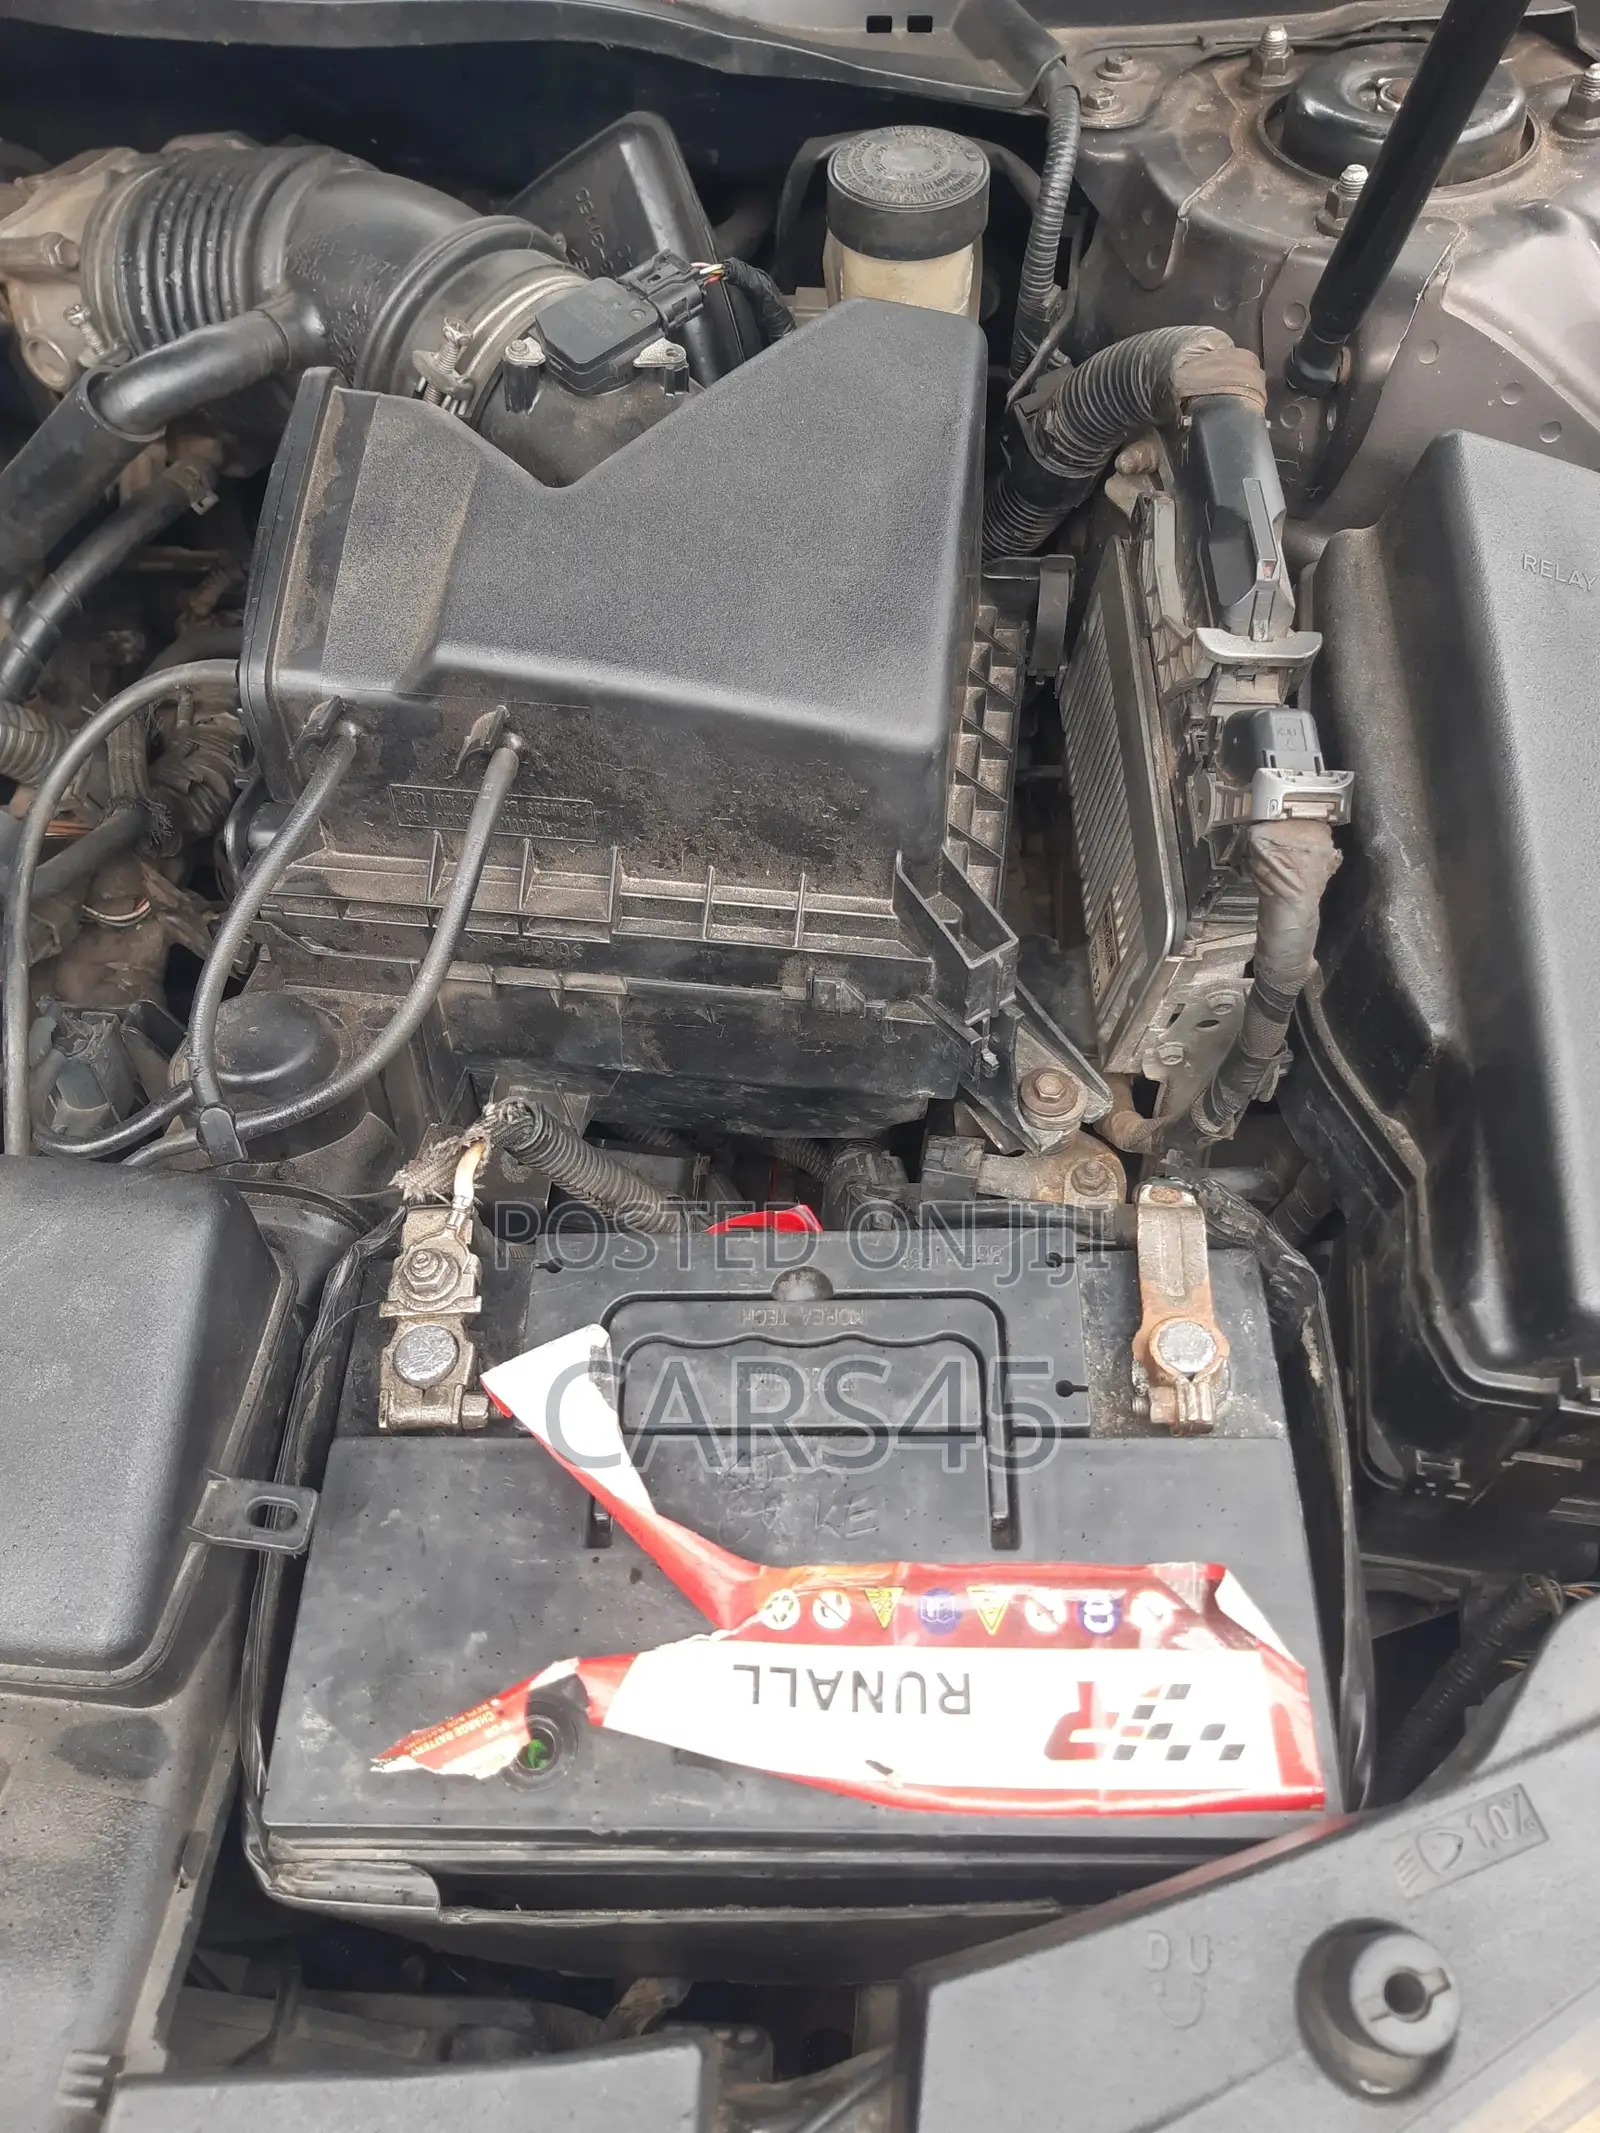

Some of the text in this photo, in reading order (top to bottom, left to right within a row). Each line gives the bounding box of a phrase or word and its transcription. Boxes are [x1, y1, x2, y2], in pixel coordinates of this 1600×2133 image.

[1522, 552, 1597, 592] RELAY
[741, 1307, 790, 1327] TECH
[732, 1664, 971, 1715] RUNALL
[410, 1711, 495, 1758] CHARGE BATTERY
